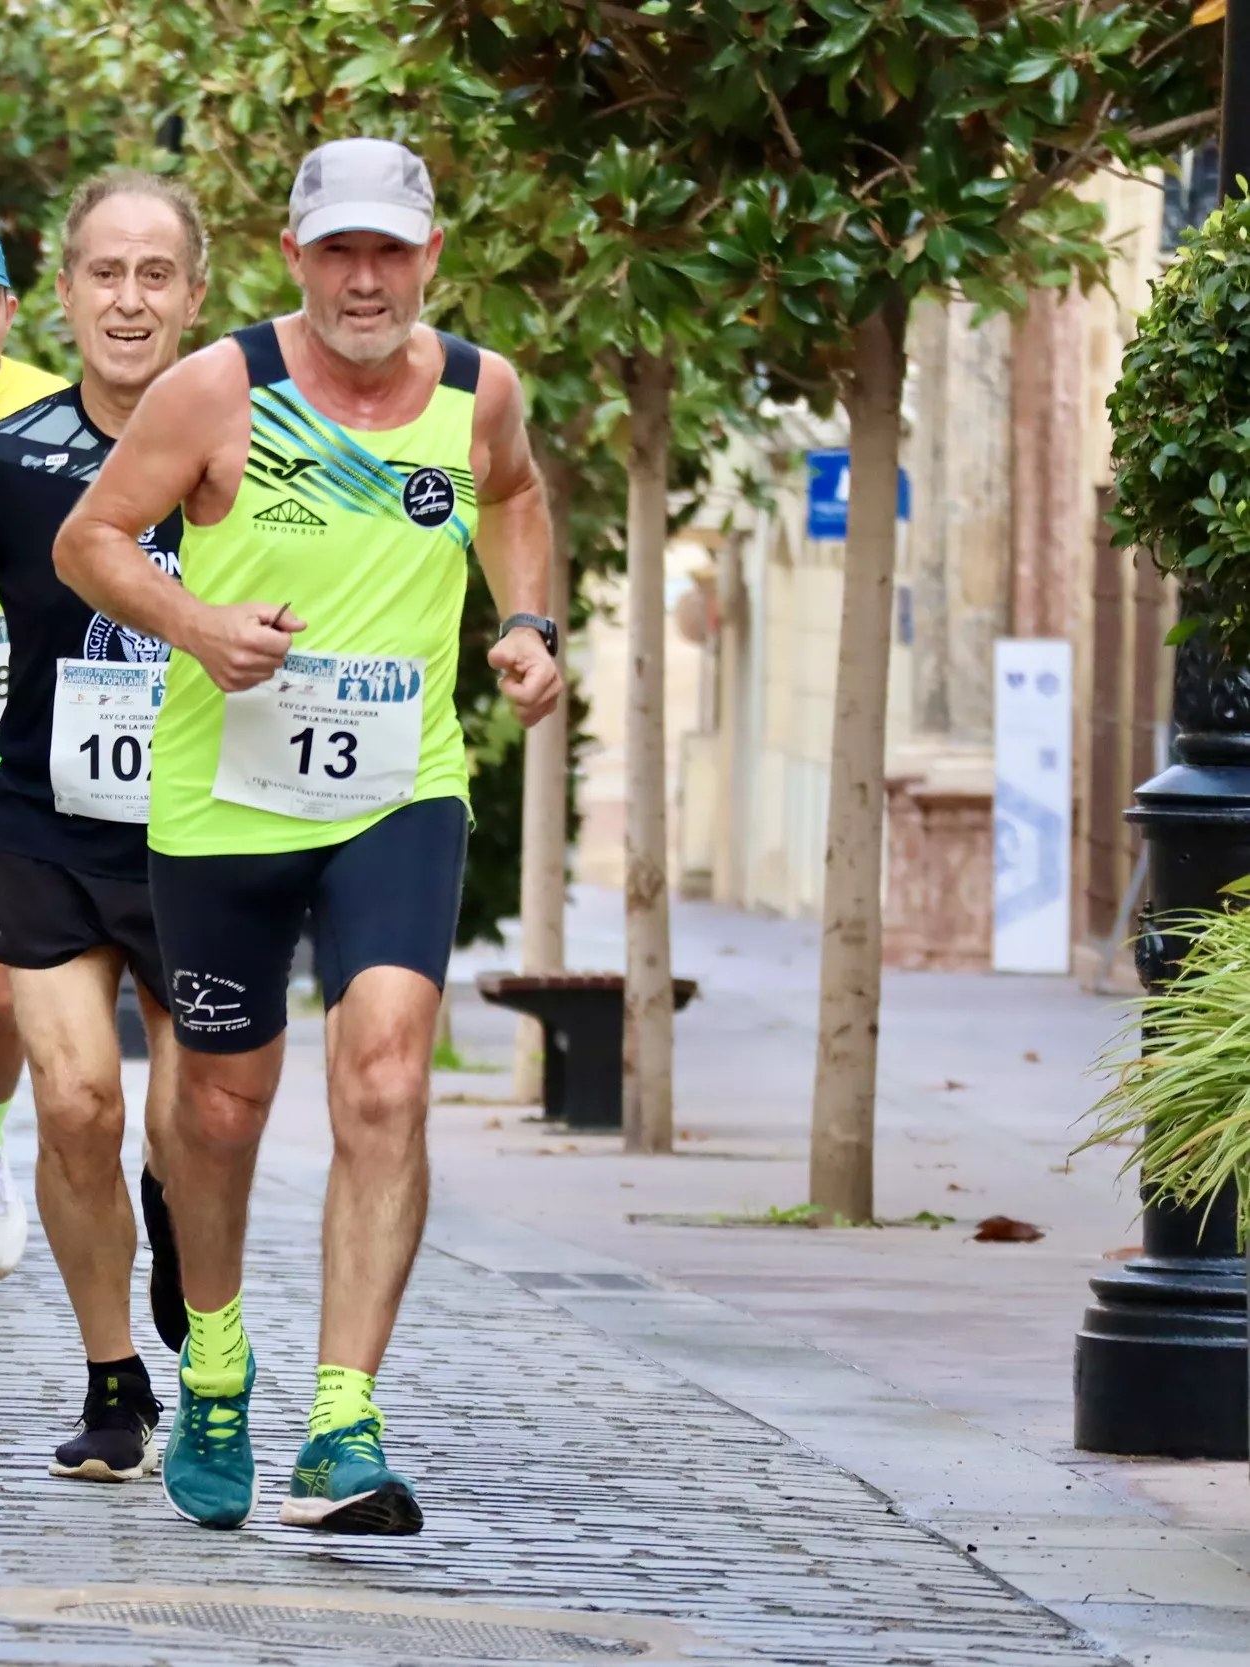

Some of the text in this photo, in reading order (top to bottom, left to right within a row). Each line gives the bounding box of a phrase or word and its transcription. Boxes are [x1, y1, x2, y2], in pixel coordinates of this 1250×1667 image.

[253, 523, 326, 536] ESMONSUR
[94, 668, 138, 678] PROVINCIAL
[139, 670, 149, 678] DE
[339, 658, 386, 680] 2024
[64, 675, 149, 686] CARRERAS POPULARES
[310, 705, 338, 715] CIUDAD
[293, 713, 307, 721] POR
[308, 715, 319, 723] LA
[290, 727, 358, 780] 13
[90, 792, 132, 801] FRANCISCO
